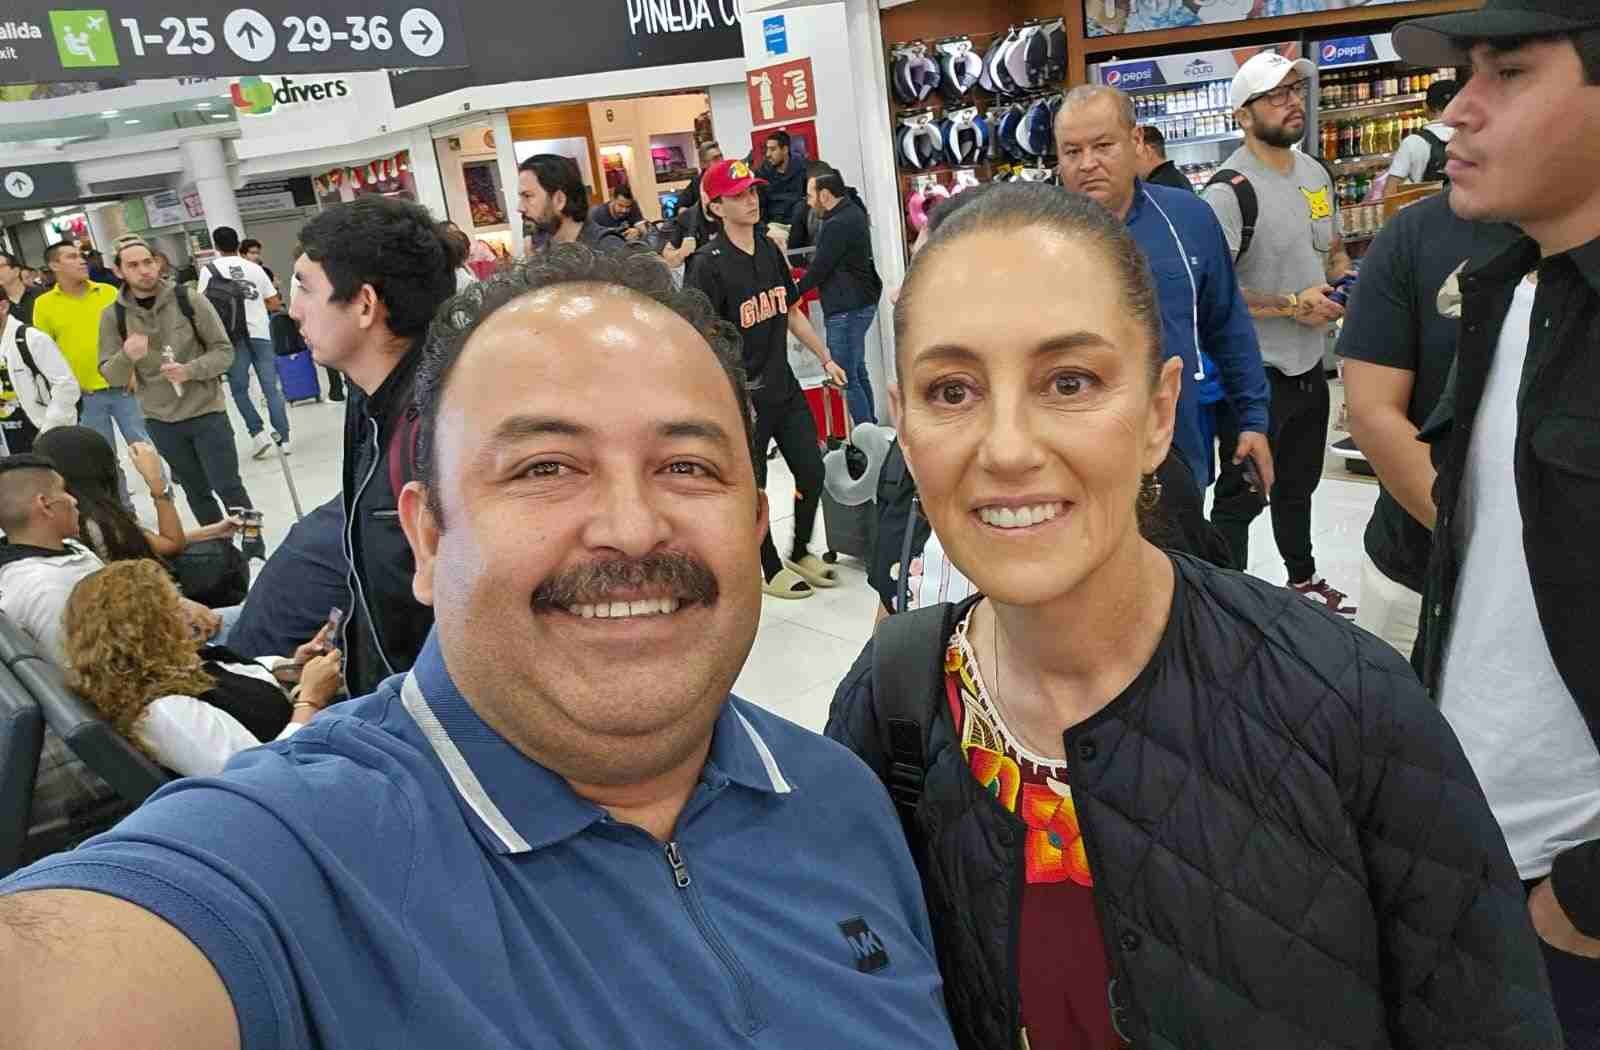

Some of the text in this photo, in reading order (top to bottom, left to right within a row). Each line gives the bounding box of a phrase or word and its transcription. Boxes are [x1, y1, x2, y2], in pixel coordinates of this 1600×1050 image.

[626, 0, 715, 35] PINEDA
[0, 21, 42, 39] alida
[120, 15, 393, 56] 1-25 29-36
[0, 46, 18, 59] xit
[1337, 44, 1365, 58] pepsi
[1122, 69, 1152, 83] pepsi
[275, 76, 348, 104] divers
